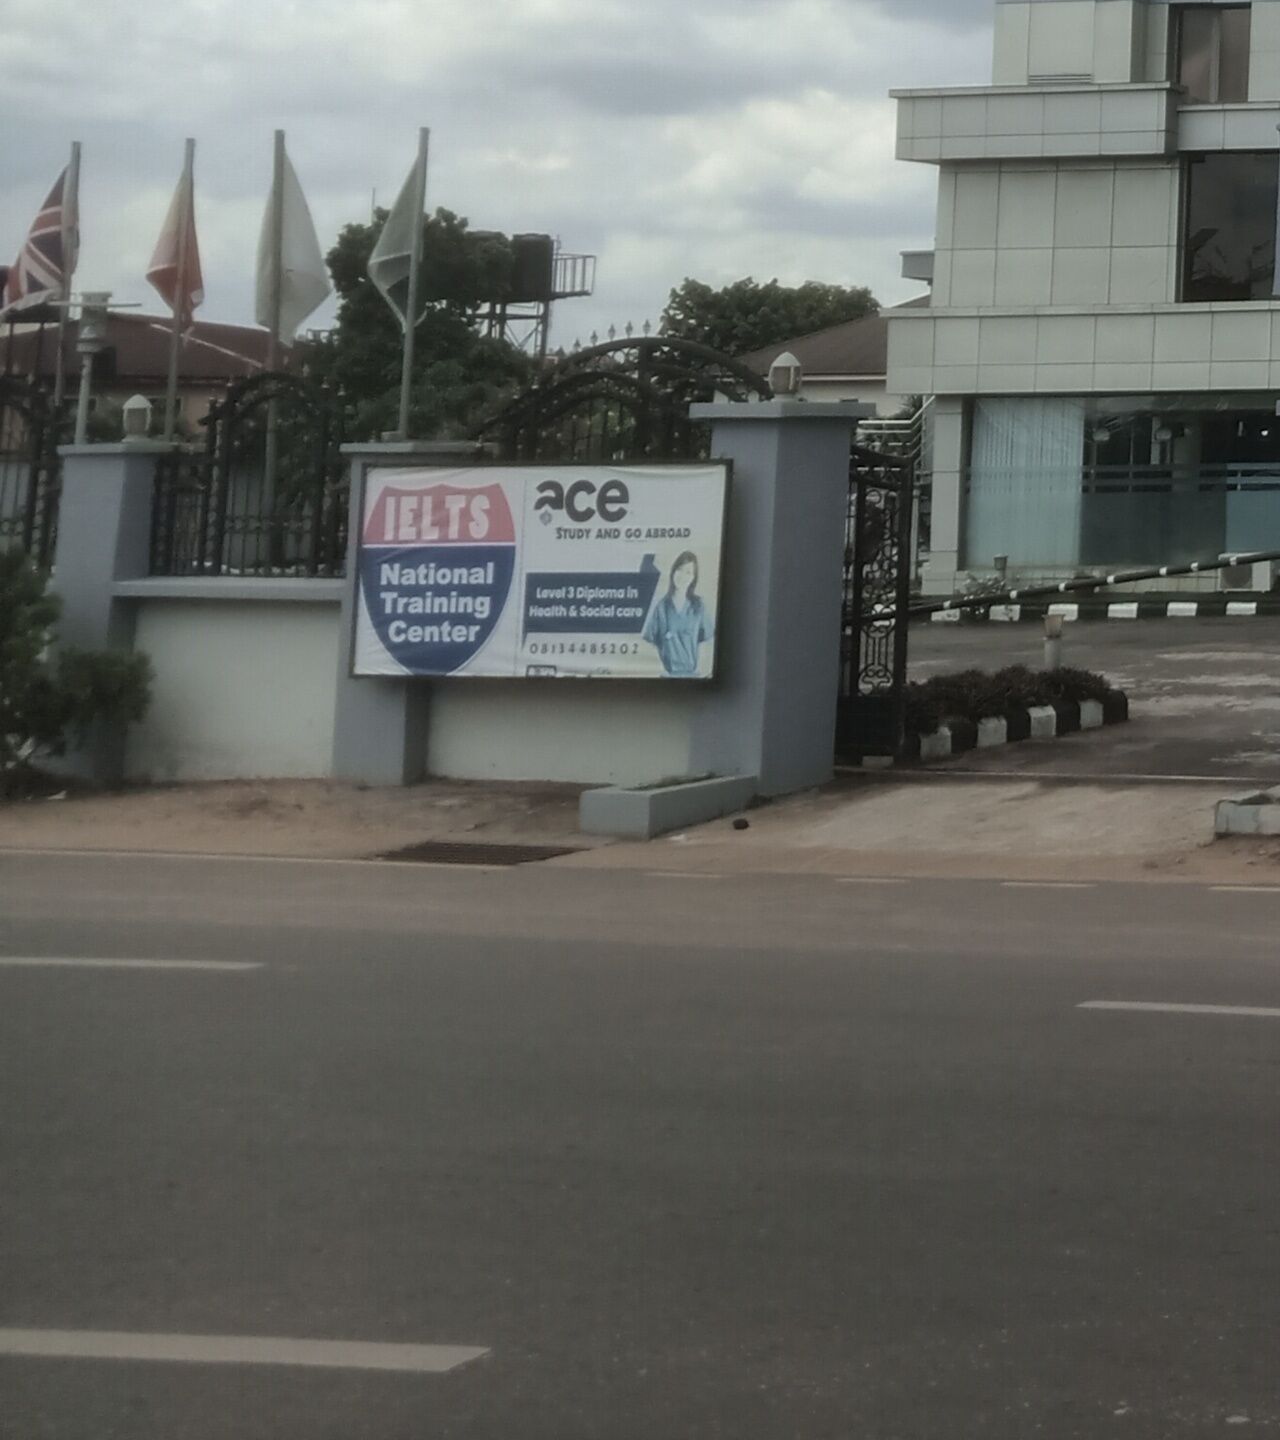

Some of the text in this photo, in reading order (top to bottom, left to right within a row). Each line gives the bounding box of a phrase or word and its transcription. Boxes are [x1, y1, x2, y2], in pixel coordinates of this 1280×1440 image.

[534, 479, 630, 523] ace
[383, 494, 490, 541] IELTS
[556, 527, 691, 540] STUDY AND GO ABROAD
[380, 562, 495, 586] National
[379, 591, 491, 619] Training
[536, 586, 639, 603] Level 3 Diploma in
[529, 604, 643, 618] Health & Social care
[388, 620, 481, 643] Center
